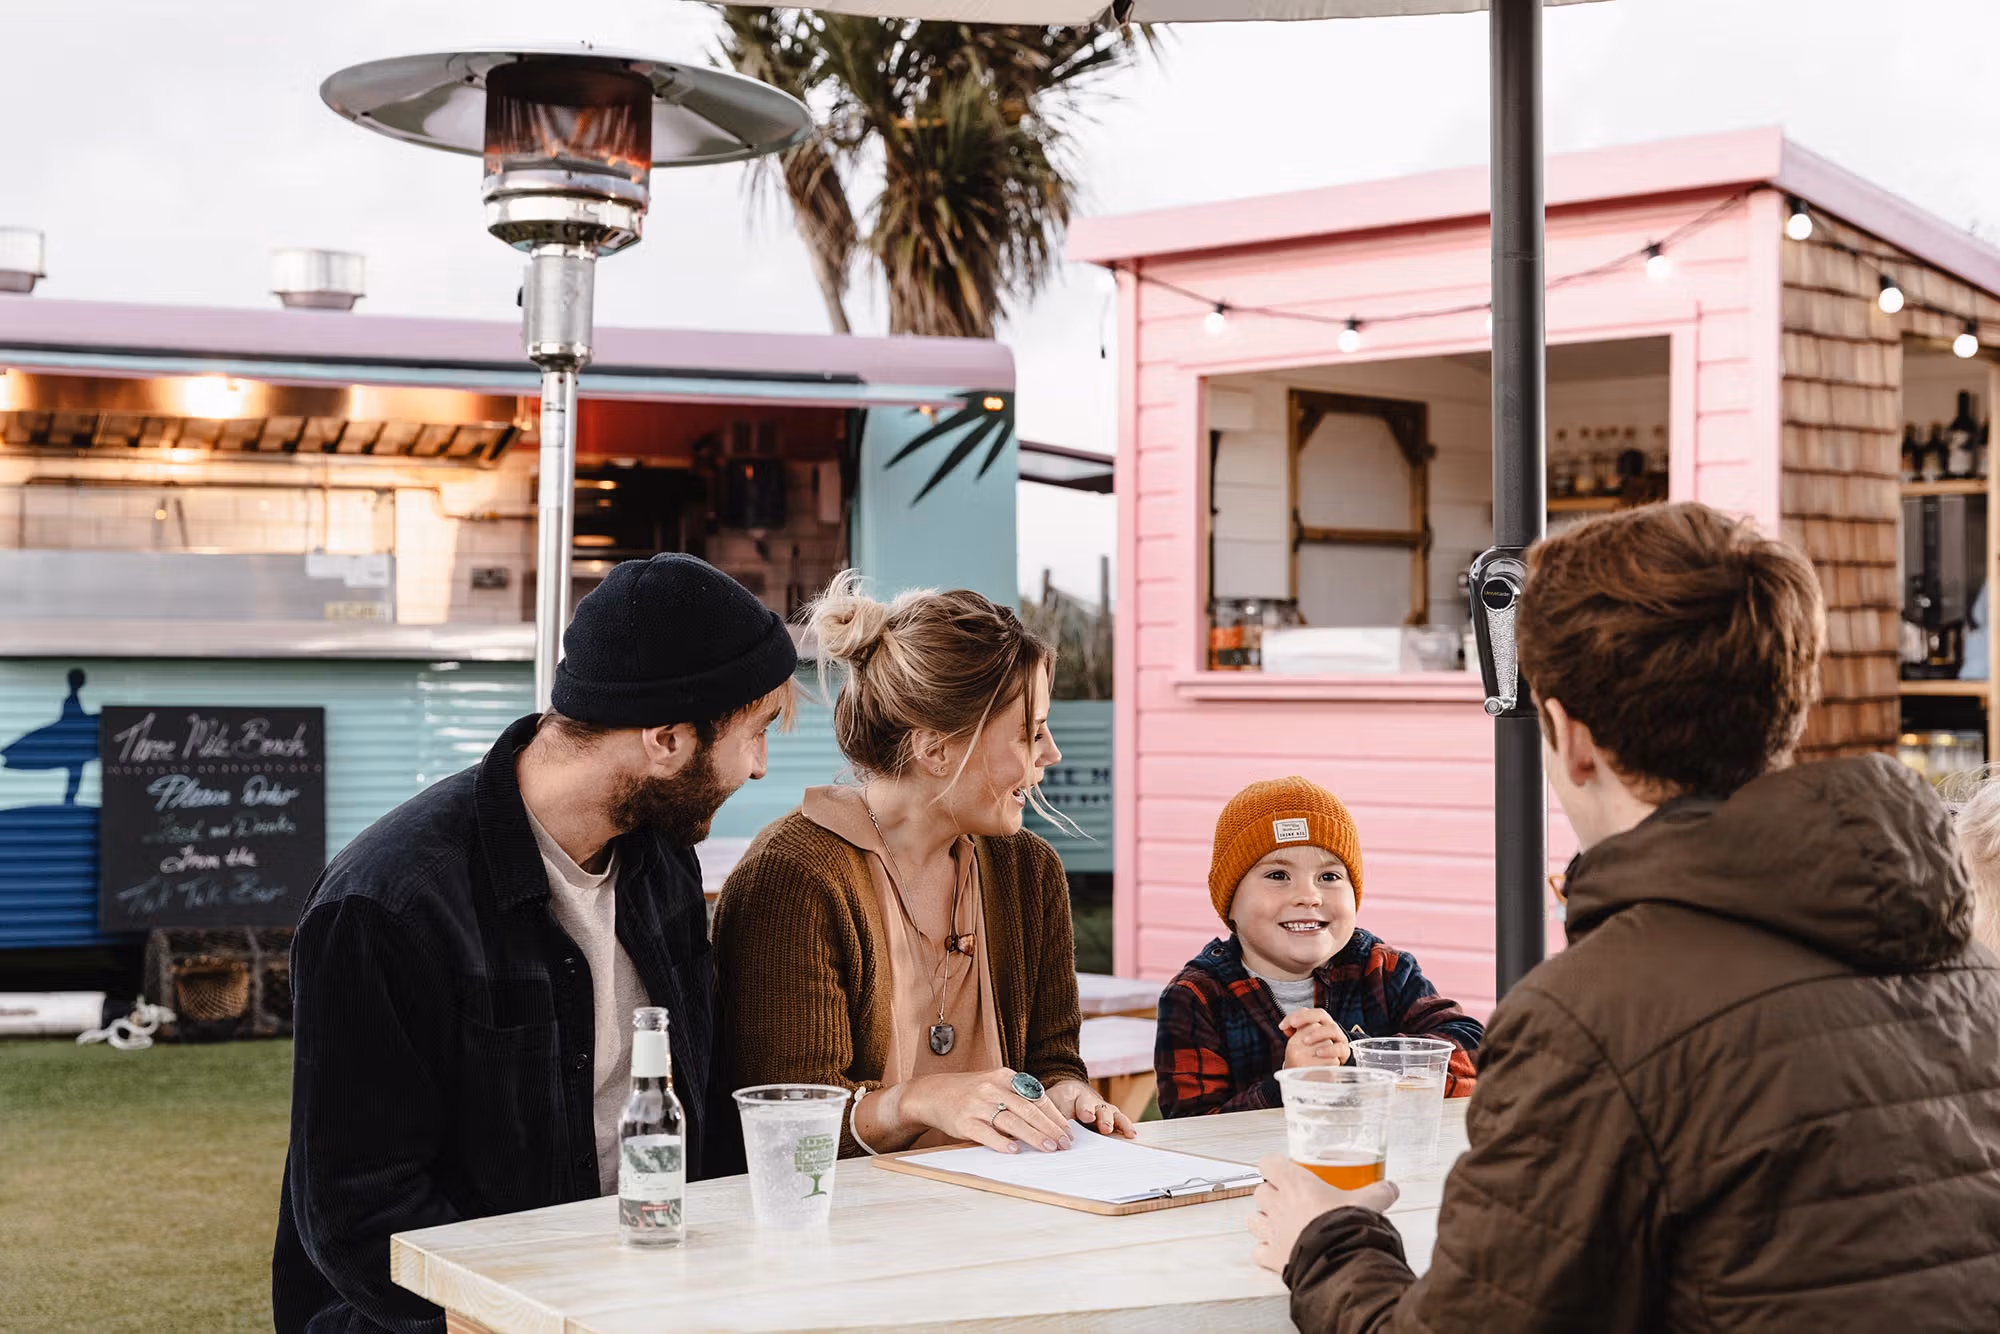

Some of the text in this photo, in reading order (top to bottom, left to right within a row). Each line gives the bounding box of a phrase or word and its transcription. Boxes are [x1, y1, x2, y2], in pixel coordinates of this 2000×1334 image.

[113, 712, 176, 762] Three
[231, 717, 308, 759] Beach
[146, 774, 299, 811] Please Order
